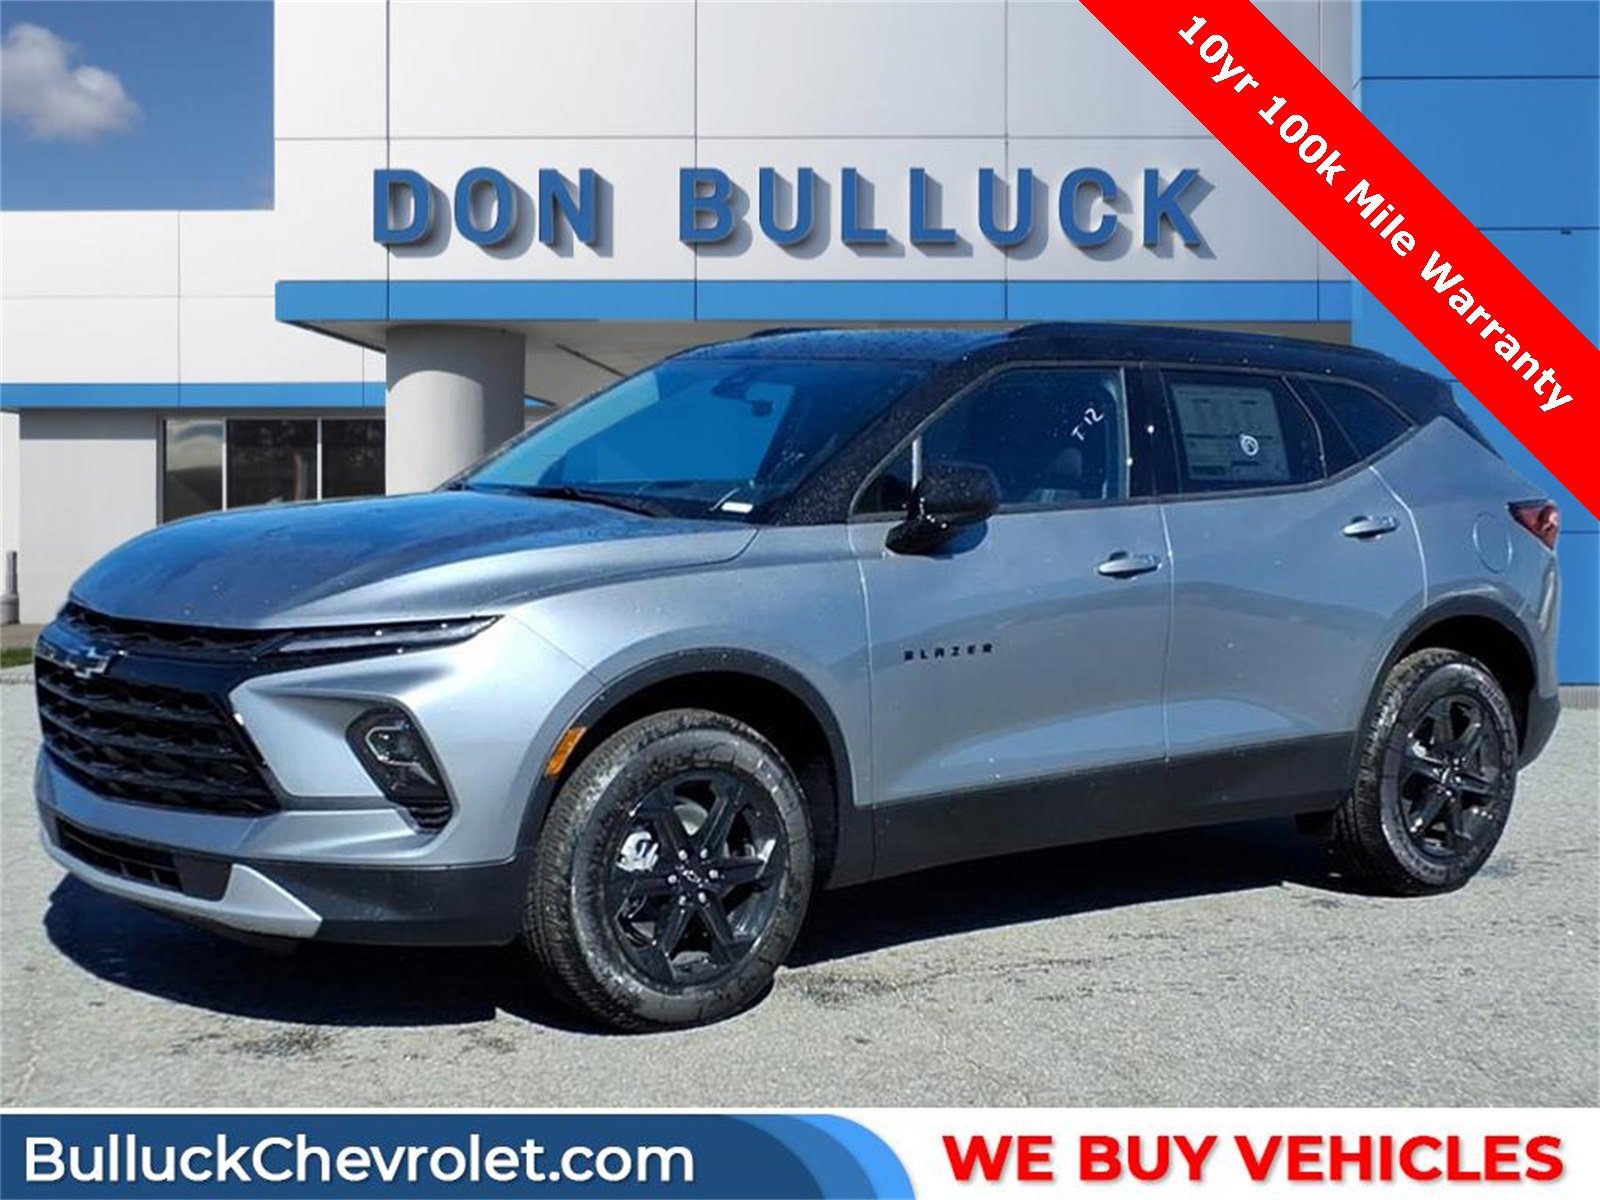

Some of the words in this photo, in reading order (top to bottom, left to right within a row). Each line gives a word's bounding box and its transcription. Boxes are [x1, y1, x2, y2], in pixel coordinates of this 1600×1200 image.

[374, 168, 596, 246] DON
[680, 168, 1201, 247] BULLUCK
[904, 643, 993, 661] BLAZER
